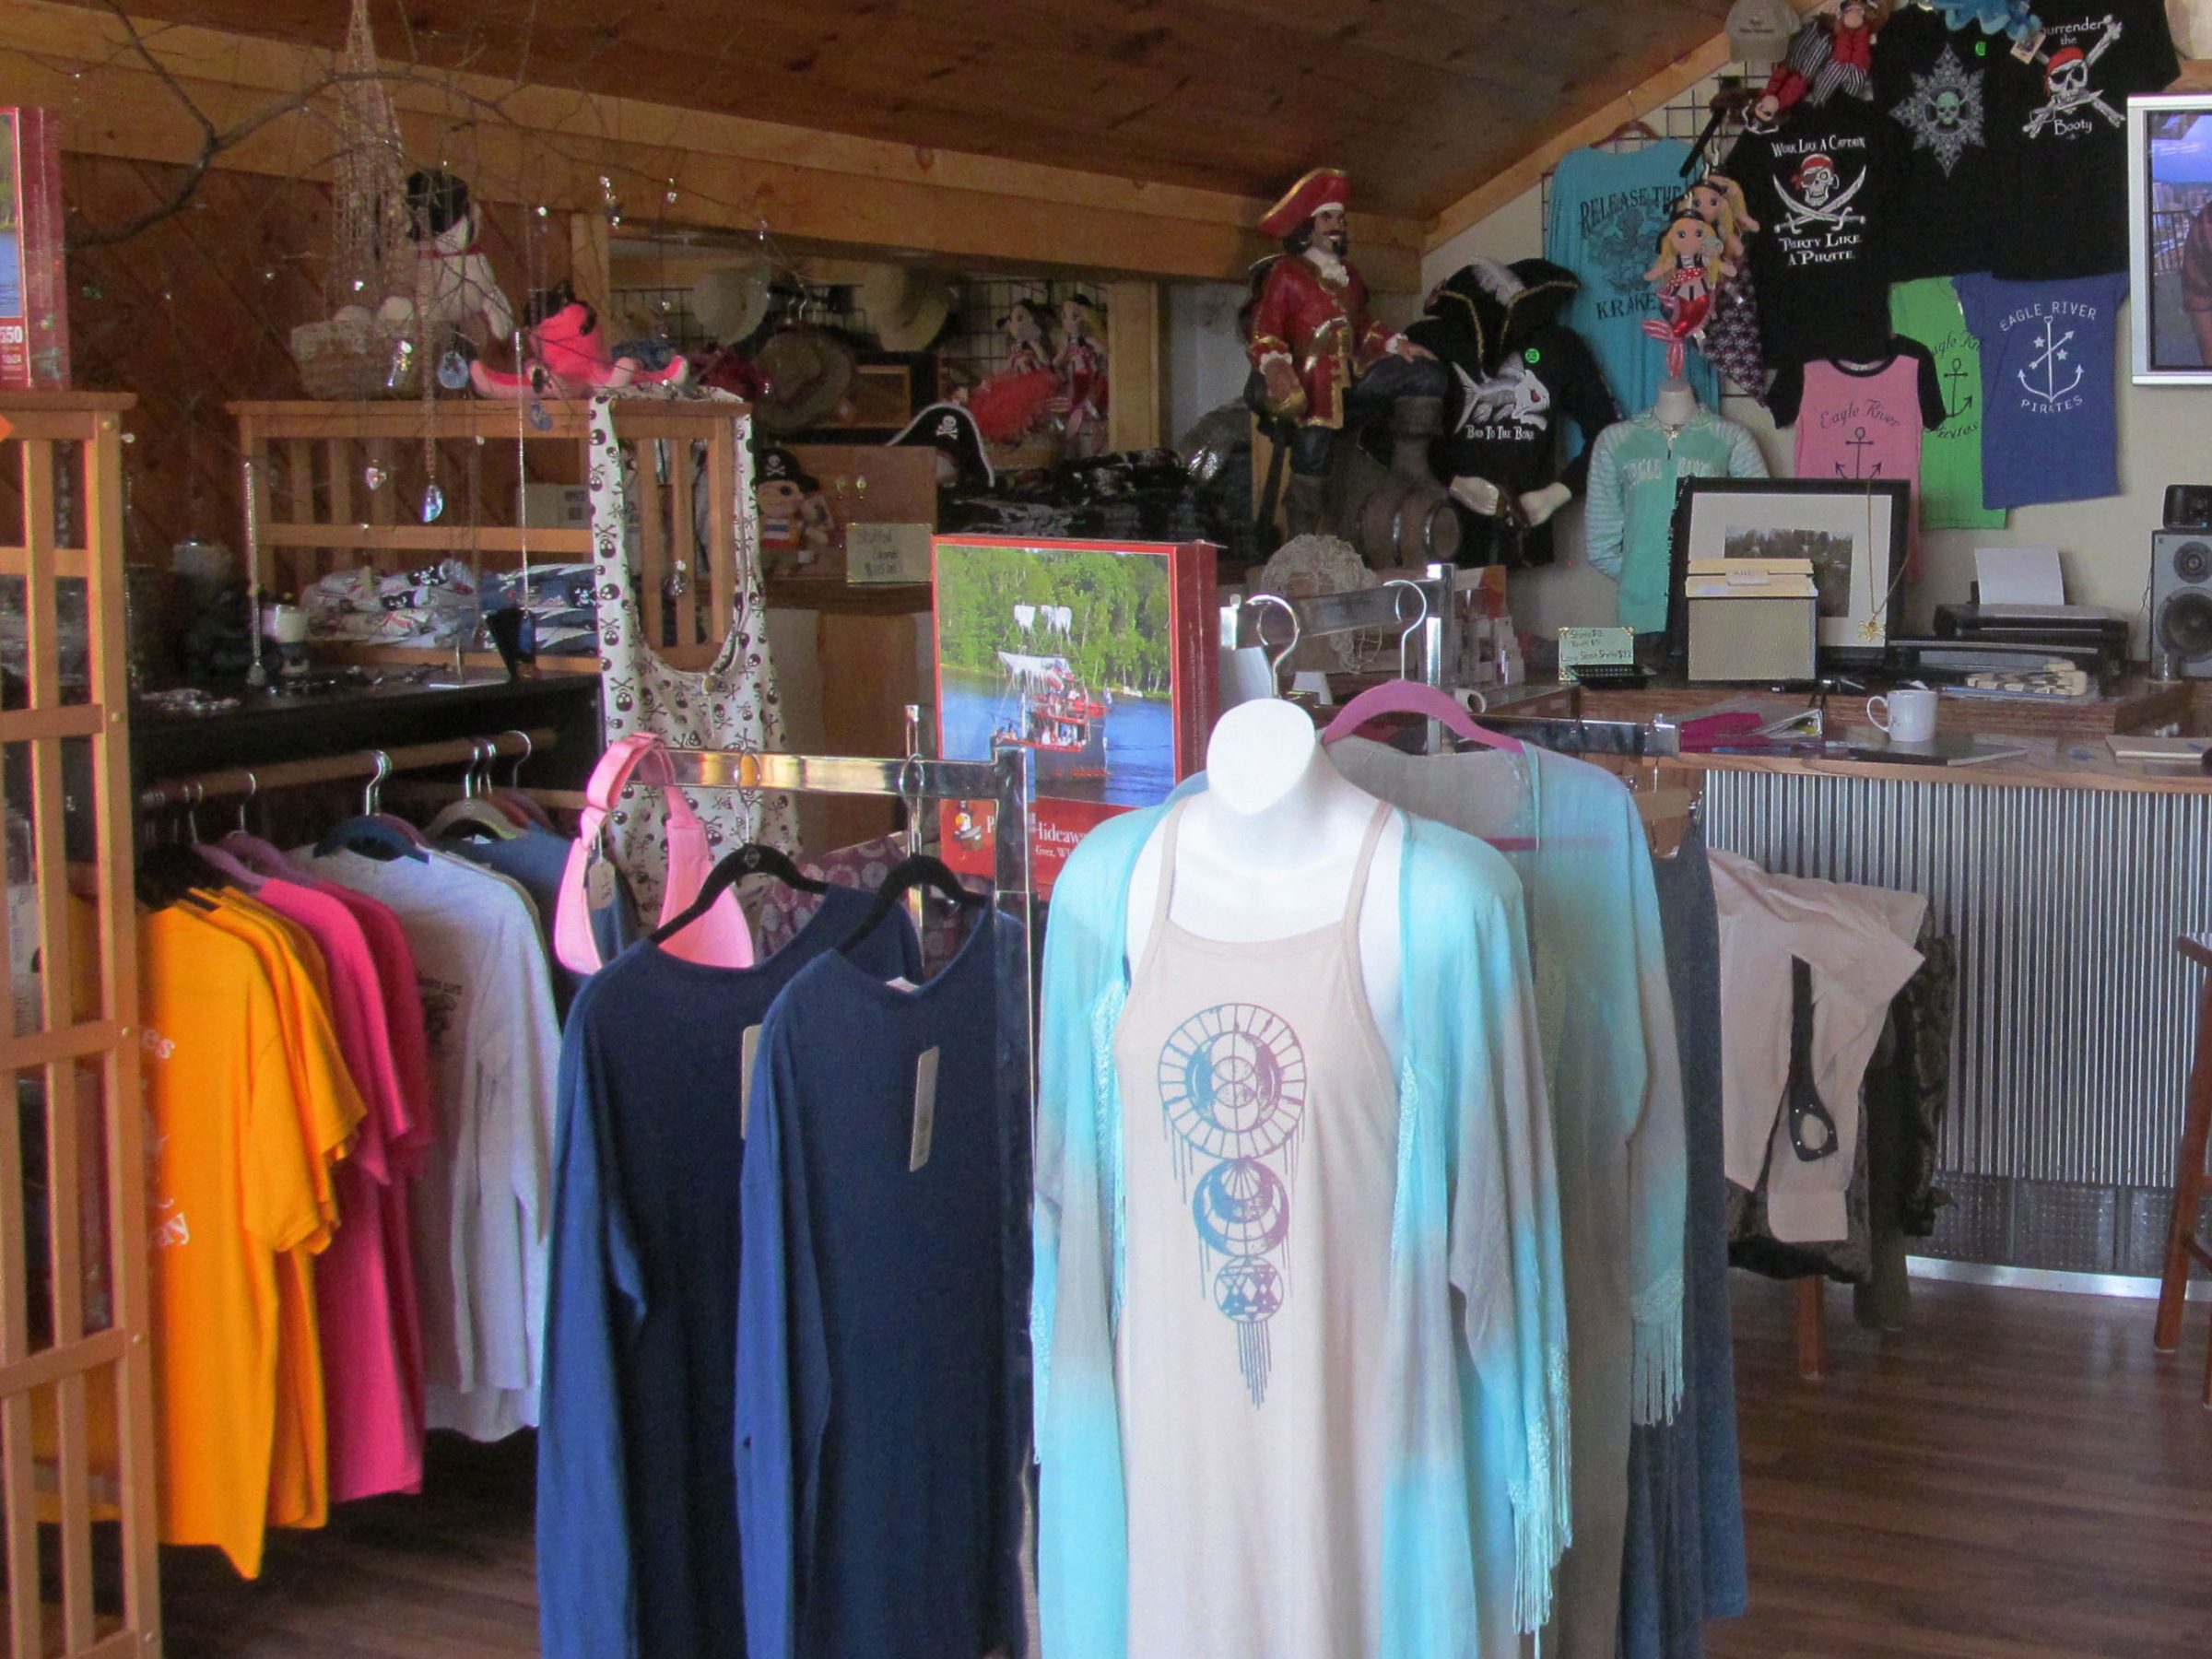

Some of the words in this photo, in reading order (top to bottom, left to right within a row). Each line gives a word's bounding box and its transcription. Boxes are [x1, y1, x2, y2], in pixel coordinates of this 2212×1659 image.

[2043, 16, 2102, 35] urrender
[2060, 33, 2077, 45] the
[2053, 119, 2093, 135] Booty
[1820, 138, 1827, 151] A
[1580, 187, 1648, 238] RELEASE
[1788, 253, 1797, 265] A
[1596, 292, 1657, 320] KRAKE
[1999, 304, 2042, 331] EAGLE
[2052, 301, 2097, 321] RIVER
[1932, 330, 1957, 359] agle
[1820, 399, 1860, 429] Eagle
[1864, 398, 1900, 426] River
[2021, 394, 2083, 414] PIRATES
[1029, 813, 1088, 843] Hideaw
